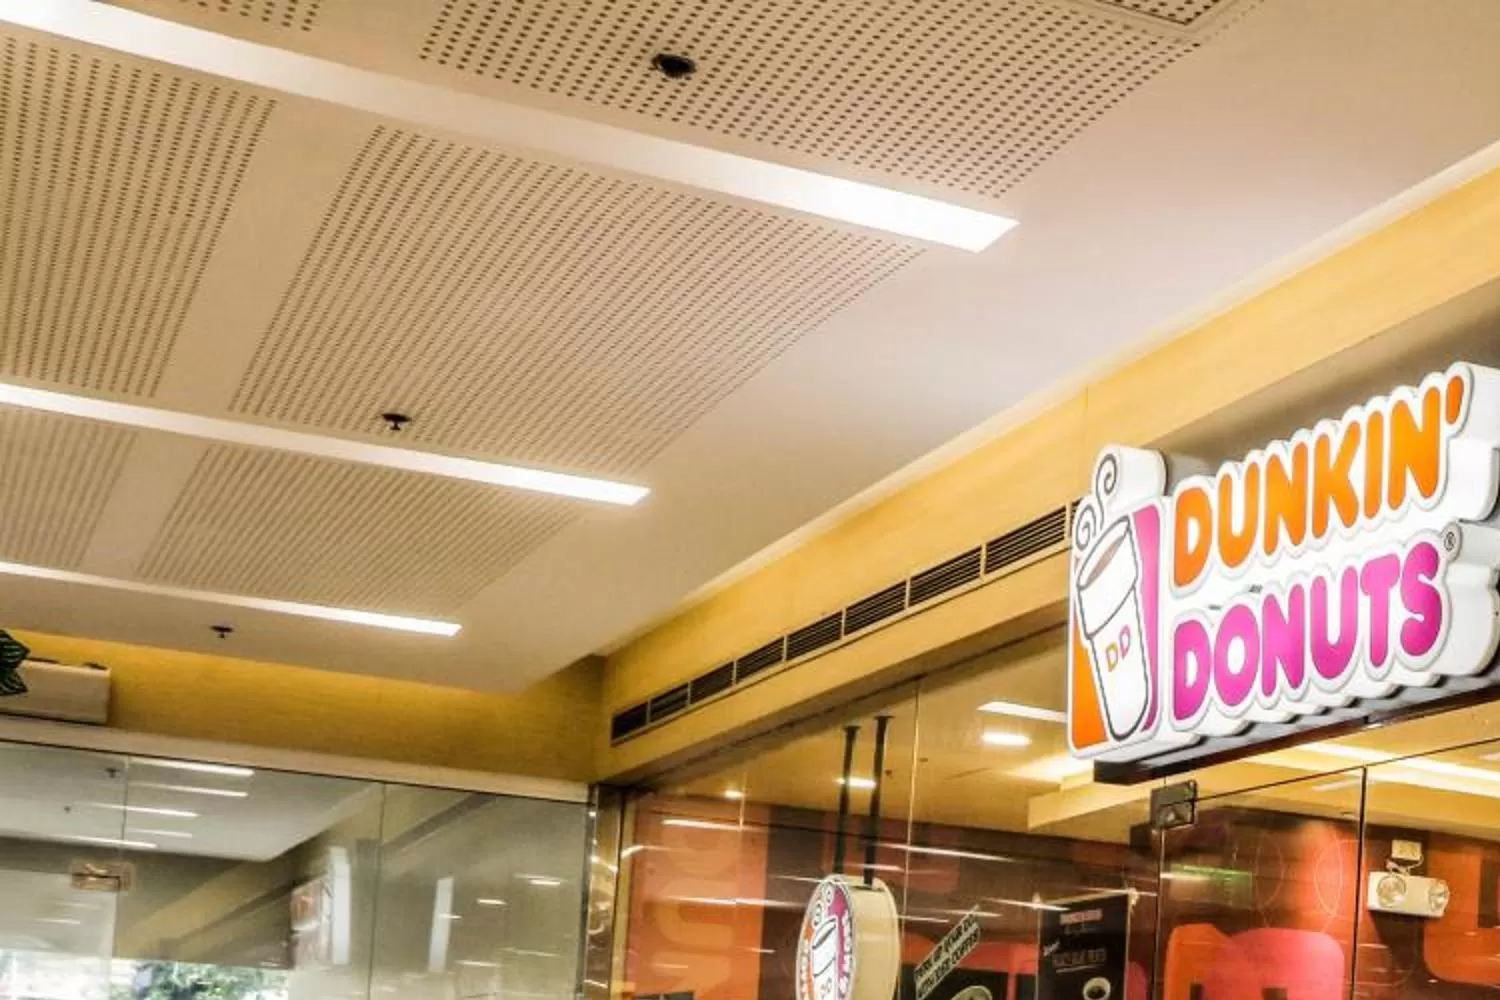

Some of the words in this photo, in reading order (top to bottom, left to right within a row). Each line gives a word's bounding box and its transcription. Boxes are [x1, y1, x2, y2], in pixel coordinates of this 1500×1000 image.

[1173, 374, 1465, 589] DUNKIN'
[1105, 625, 1132, 674] DD
[1172, 541, 1443, 722] DONUTS
